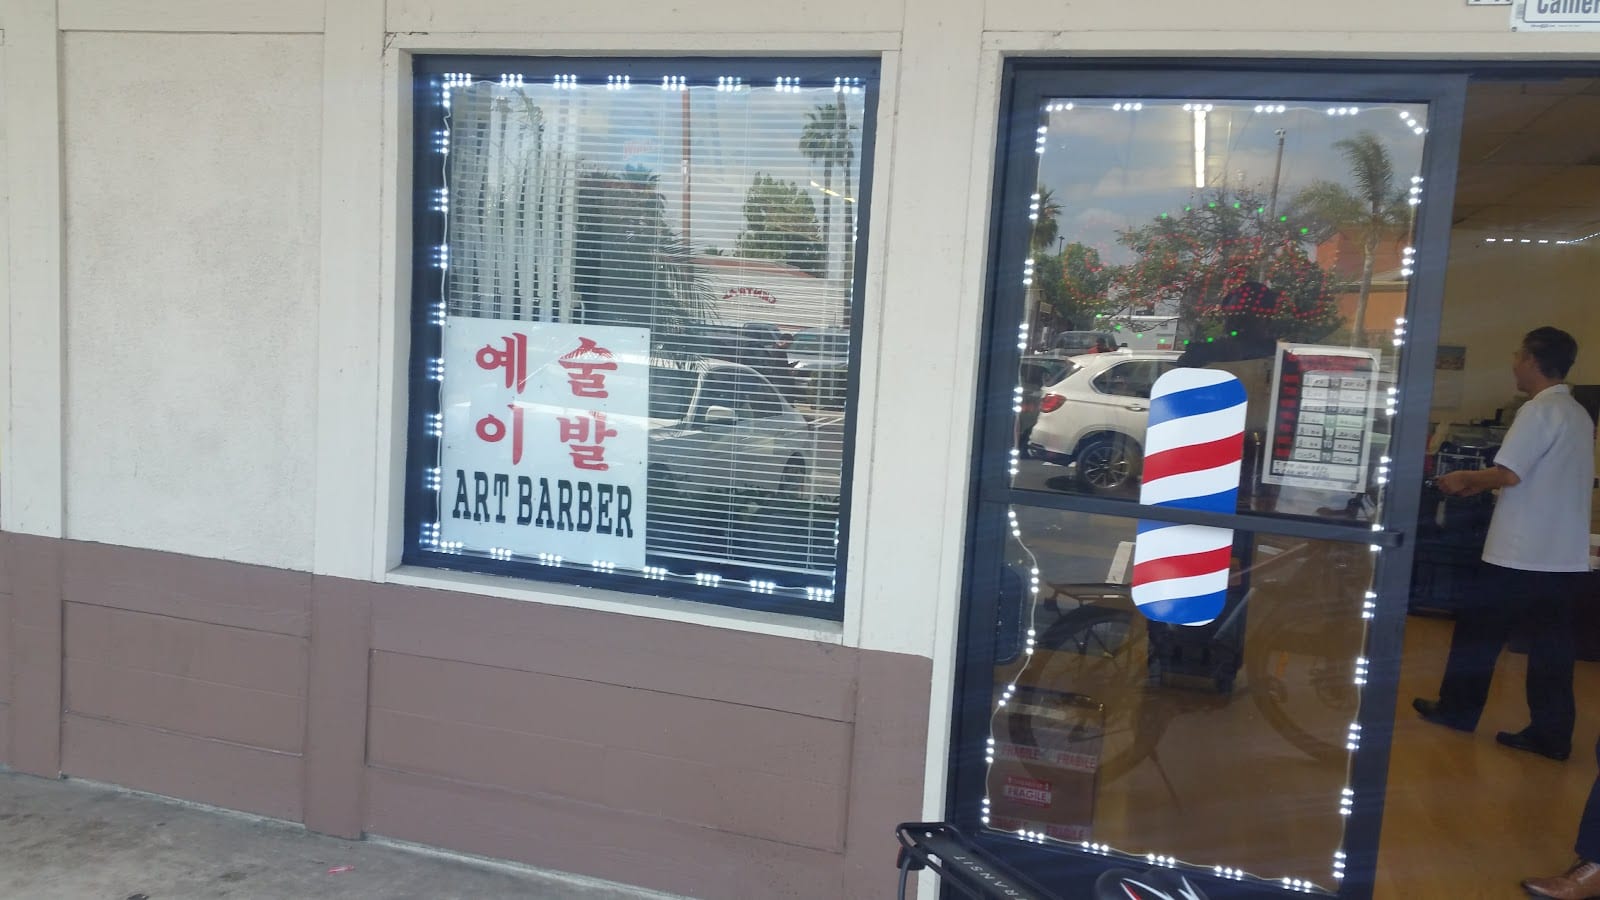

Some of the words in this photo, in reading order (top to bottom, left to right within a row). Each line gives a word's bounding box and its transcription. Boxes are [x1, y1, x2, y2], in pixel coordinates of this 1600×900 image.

[452, 469, 509, 523] ART
[517, 475, 633, 538] BARBER
[1008, 786, 1046, 801] FRAGILE
